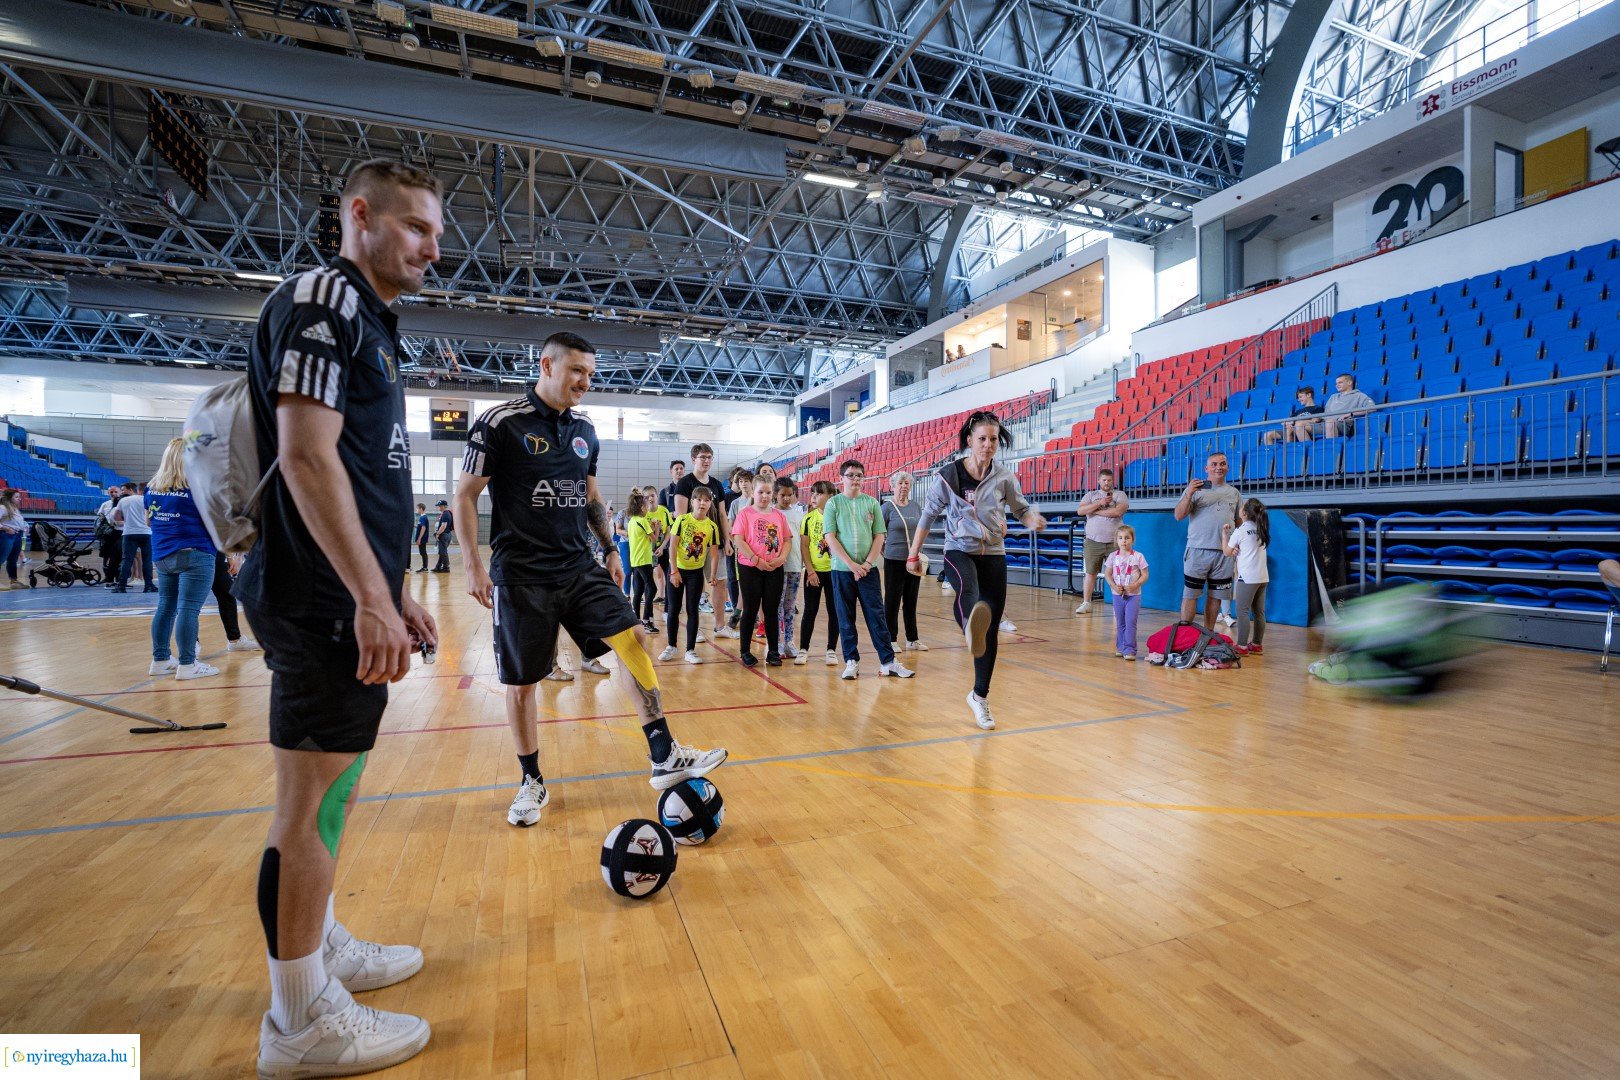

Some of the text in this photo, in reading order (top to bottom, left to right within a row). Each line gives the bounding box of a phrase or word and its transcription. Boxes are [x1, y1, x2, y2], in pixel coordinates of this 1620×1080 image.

[1451, 58, 1518, 95] Eissmann
[1451, 91, 1475, 103] Group
[301, 330, 337, 346] adidas
[531, 496, 587, 508] STUDIO
